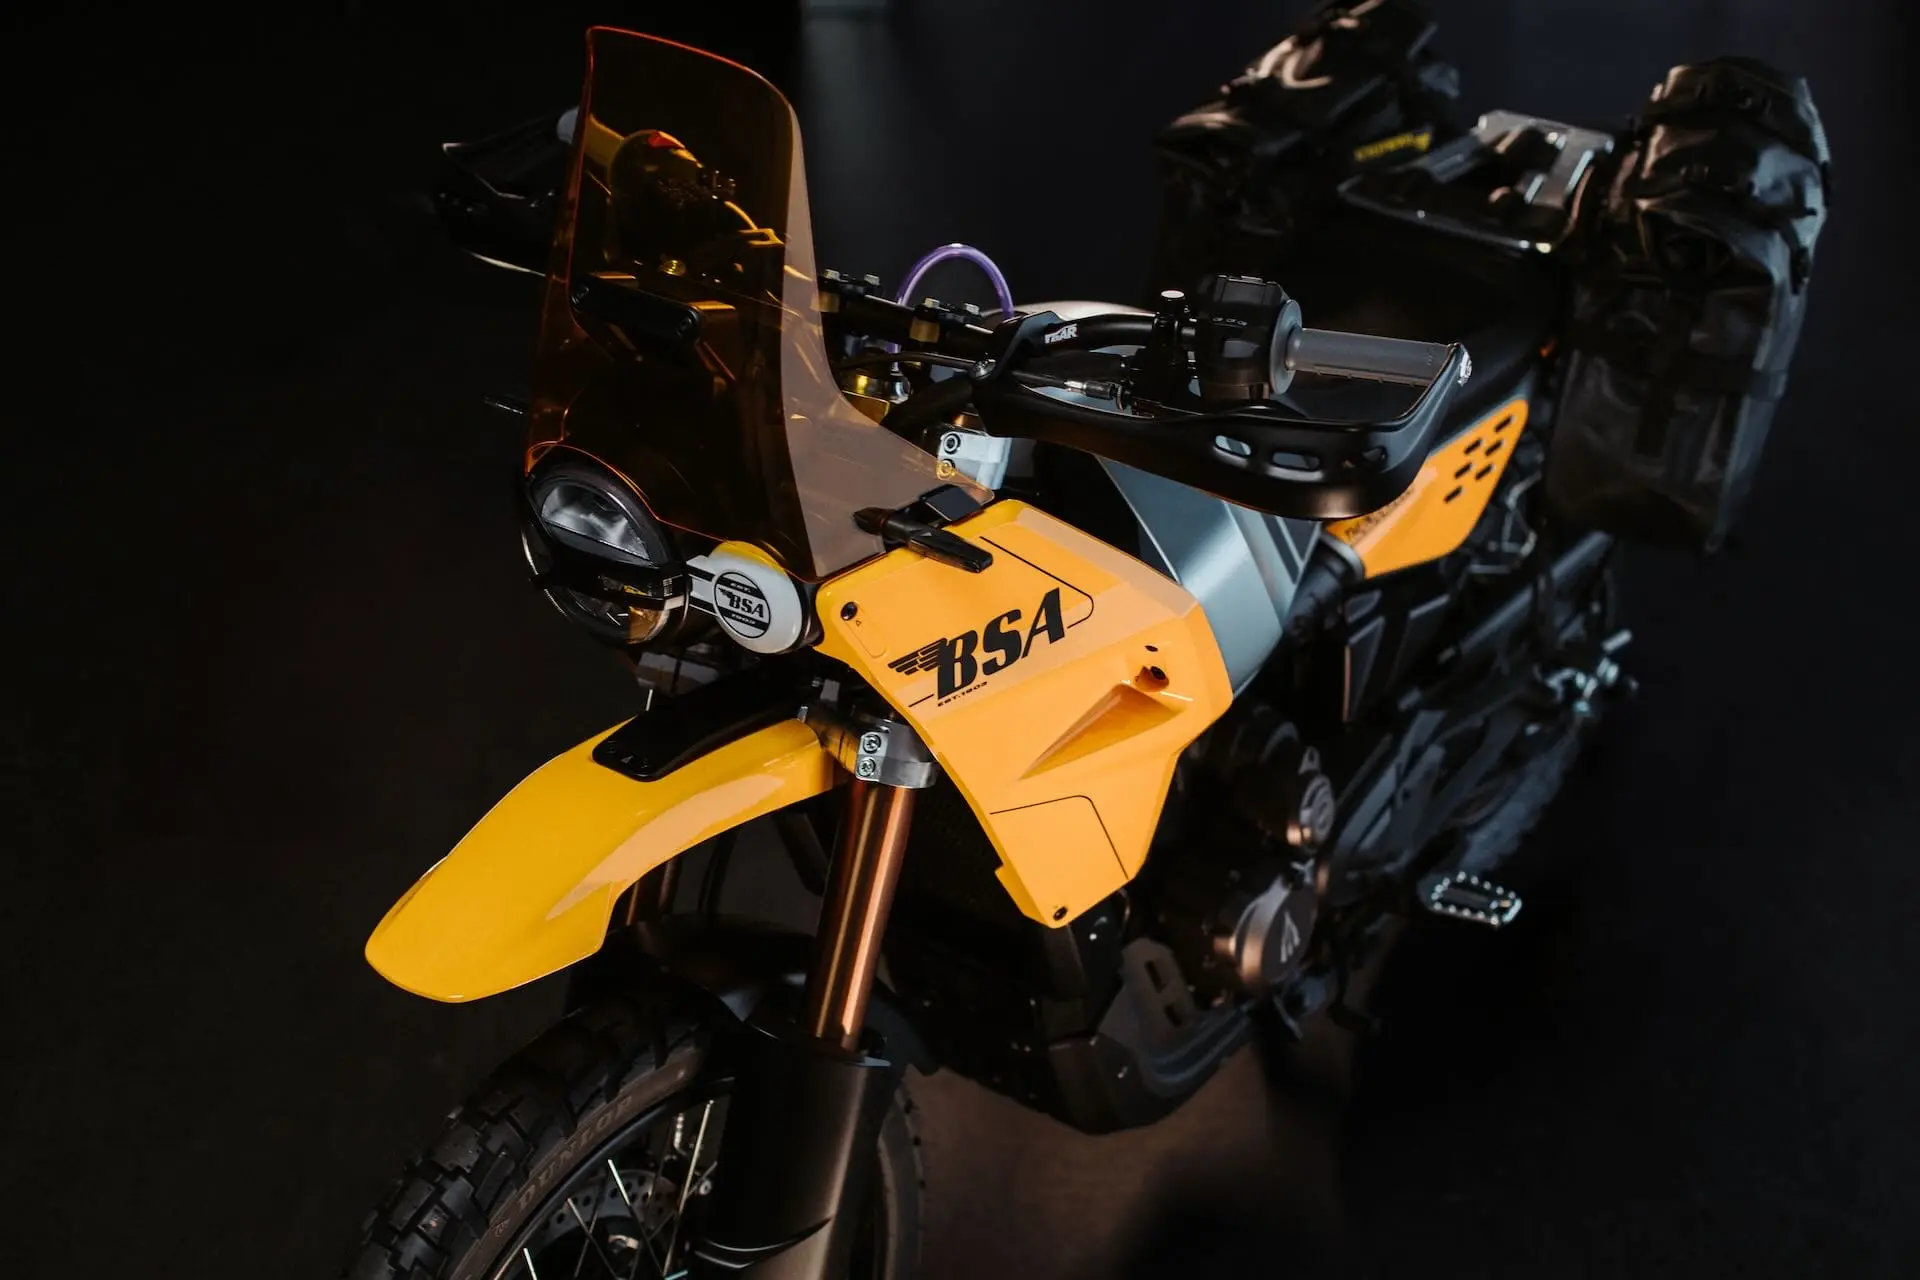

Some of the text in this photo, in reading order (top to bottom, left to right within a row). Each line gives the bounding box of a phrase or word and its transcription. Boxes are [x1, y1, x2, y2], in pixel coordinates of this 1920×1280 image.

[729, 594, 764, 618] BSA
[937, 587, 1065, 700] BSA
[517, 1096, 632, 1211] DUNLOP
